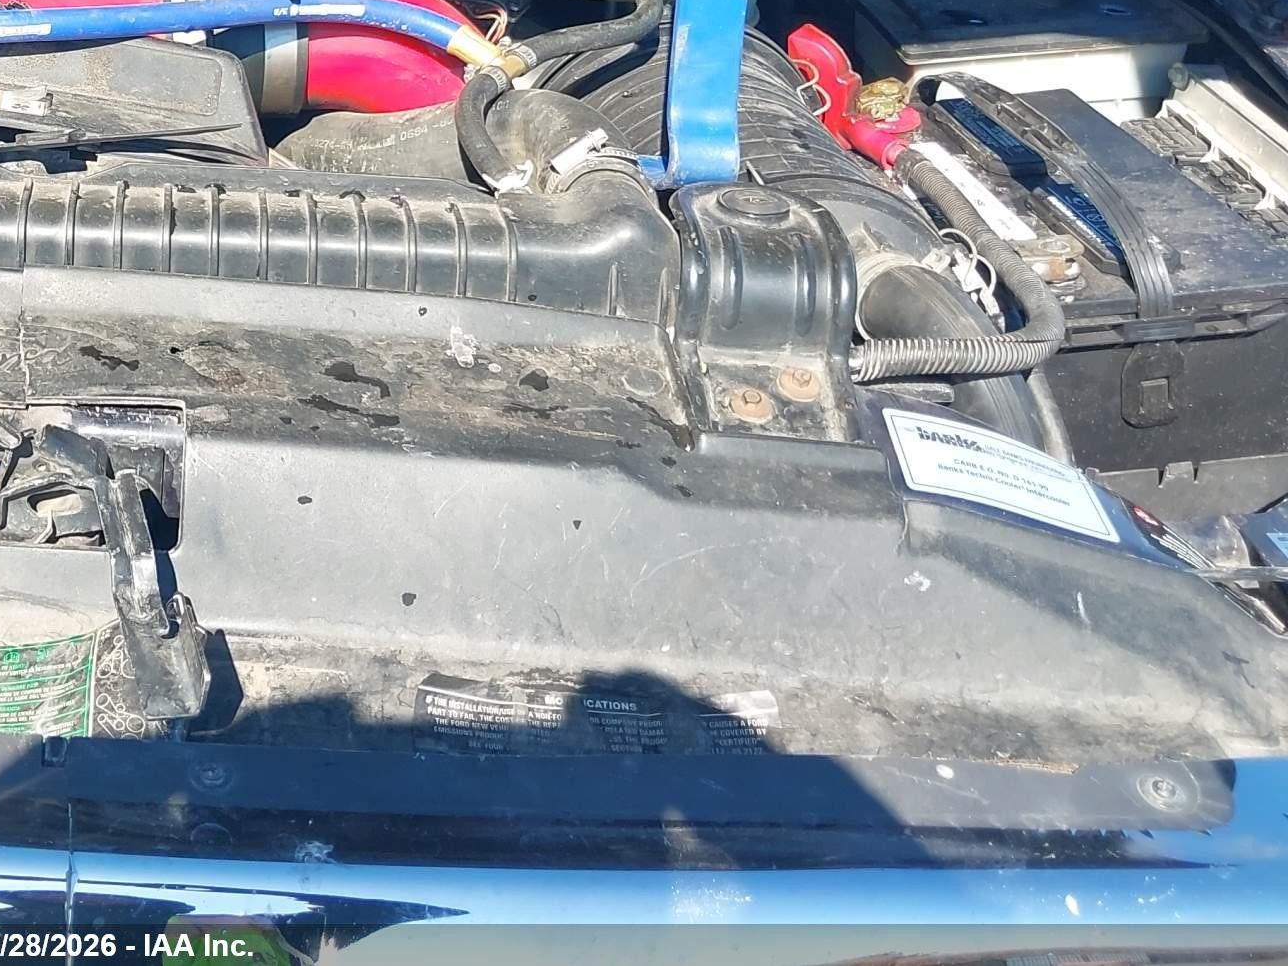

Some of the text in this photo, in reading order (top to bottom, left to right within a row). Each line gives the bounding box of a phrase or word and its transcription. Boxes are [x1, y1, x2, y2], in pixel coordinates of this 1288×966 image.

[427, 706, 446, 716] PART
[448, 709, 457, 718] TO
[479, 714, 494, 722] THE
[720, 728, 755, 737] COVERED
[756, 727, 767, 736] BY
[434, 695, 449, 705] THE
[748, 718, 768, 727] FORD
[435, 717, 449, 726] THE
[450, 719, 470, 728] FORD
[471, 721, 488, 730] NEW
